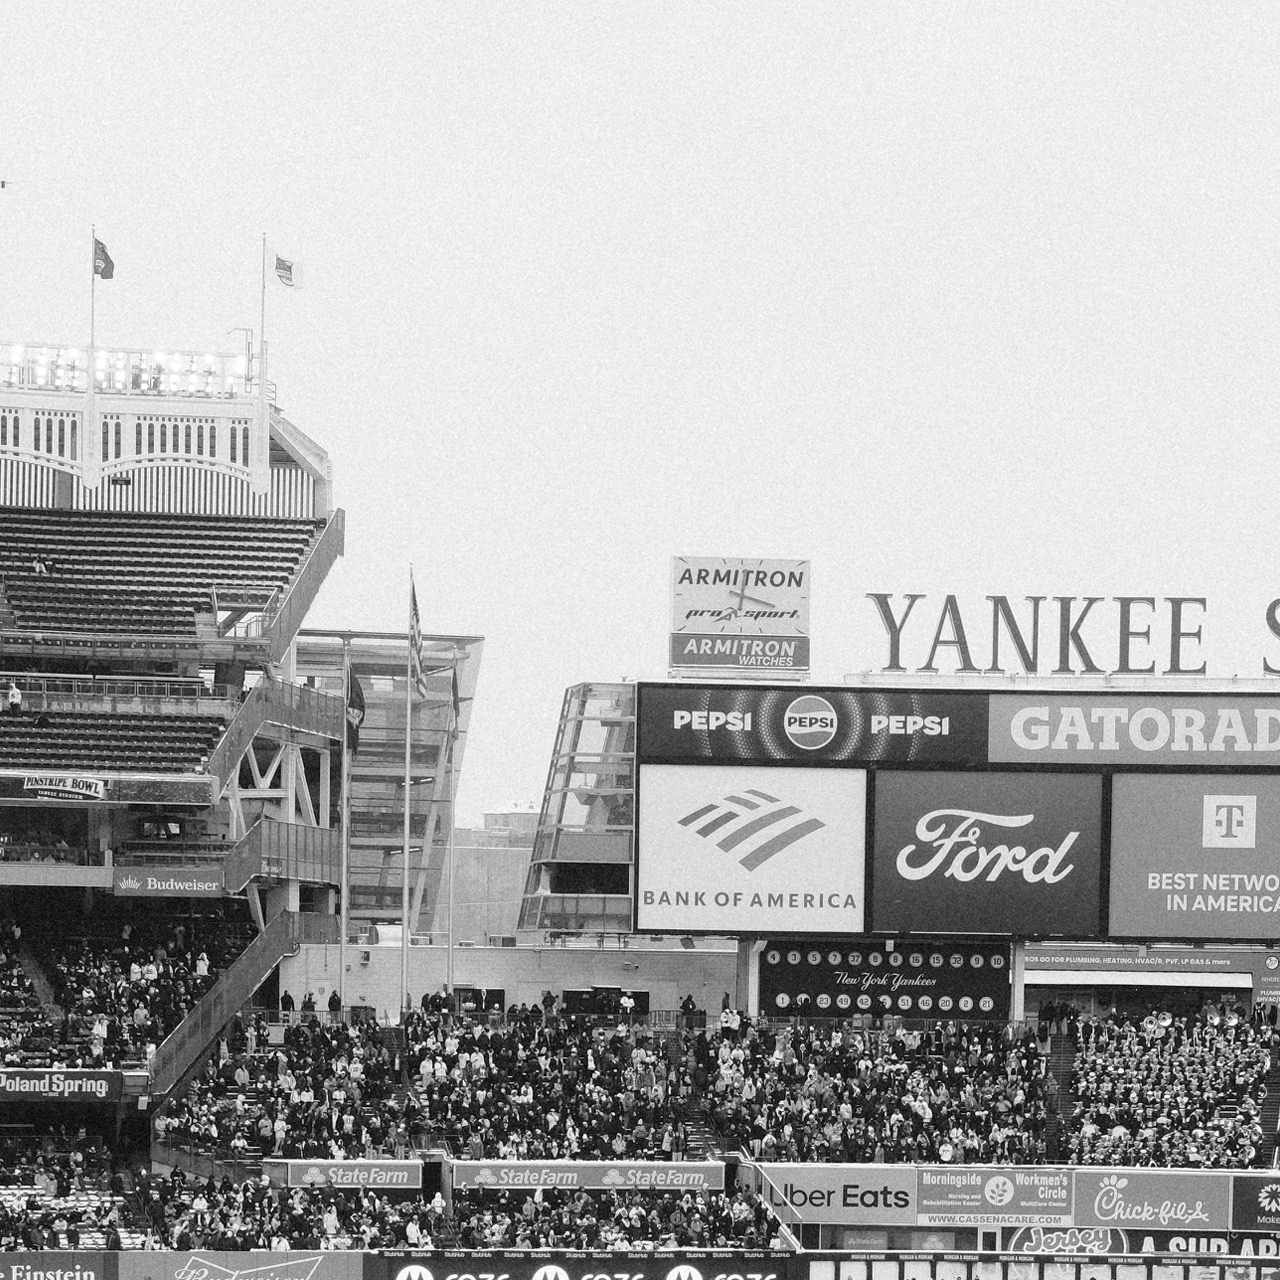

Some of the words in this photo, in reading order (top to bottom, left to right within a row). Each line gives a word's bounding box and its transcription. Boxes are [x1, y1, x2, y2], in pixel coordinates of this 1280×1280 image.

[678, 567, 804, 589] ARMITRON
[865, 593, 1207, 677] YANKEE
[684, 638, 795, 657] ARMITRON
[738, 655, 794, 667] WATCHES
[673, 710, 752, 732] PEPSI
[787, 716, 835, 730] PEPSI
[870, 715, 950, 736] PEPSI
[26, 776, 69, 788] PINSTRIPE
[72, 778, 100, 794] BOWL
[895, 808, 1081, 884] Ford
[146, 877, 219, 891] Budweiser
[1148, 872, 1198, 890] BEST
[642, 889, 708, 907] BANK
[713, 890, 744, 908] OF
[749, 891, 858, 909] AMERICA
[1166, 894, 1188, 911] IN
[834, 971, 860, 986] New
[861, 972, 888, 991] York
[890, 973, 937, 992] Yankees
[51, 1073, 108, 1097] Spring
[922, 1173, 982, 1188] Morningside
[1015, 1174, 1068, 1186] Workmen's
[842, 1184, 910, 1209] Eats
[1039, 1186, 1067, 1199] Circle
[1094, 1183, 1211, 1224] Chick-fil-A
[928, 1215, 1062, 1225] WWW.CASSENACARE.COM
[1257, 1215, 1280, 1225] Make
[1024, 1227, 1111, 1252] Jersey
